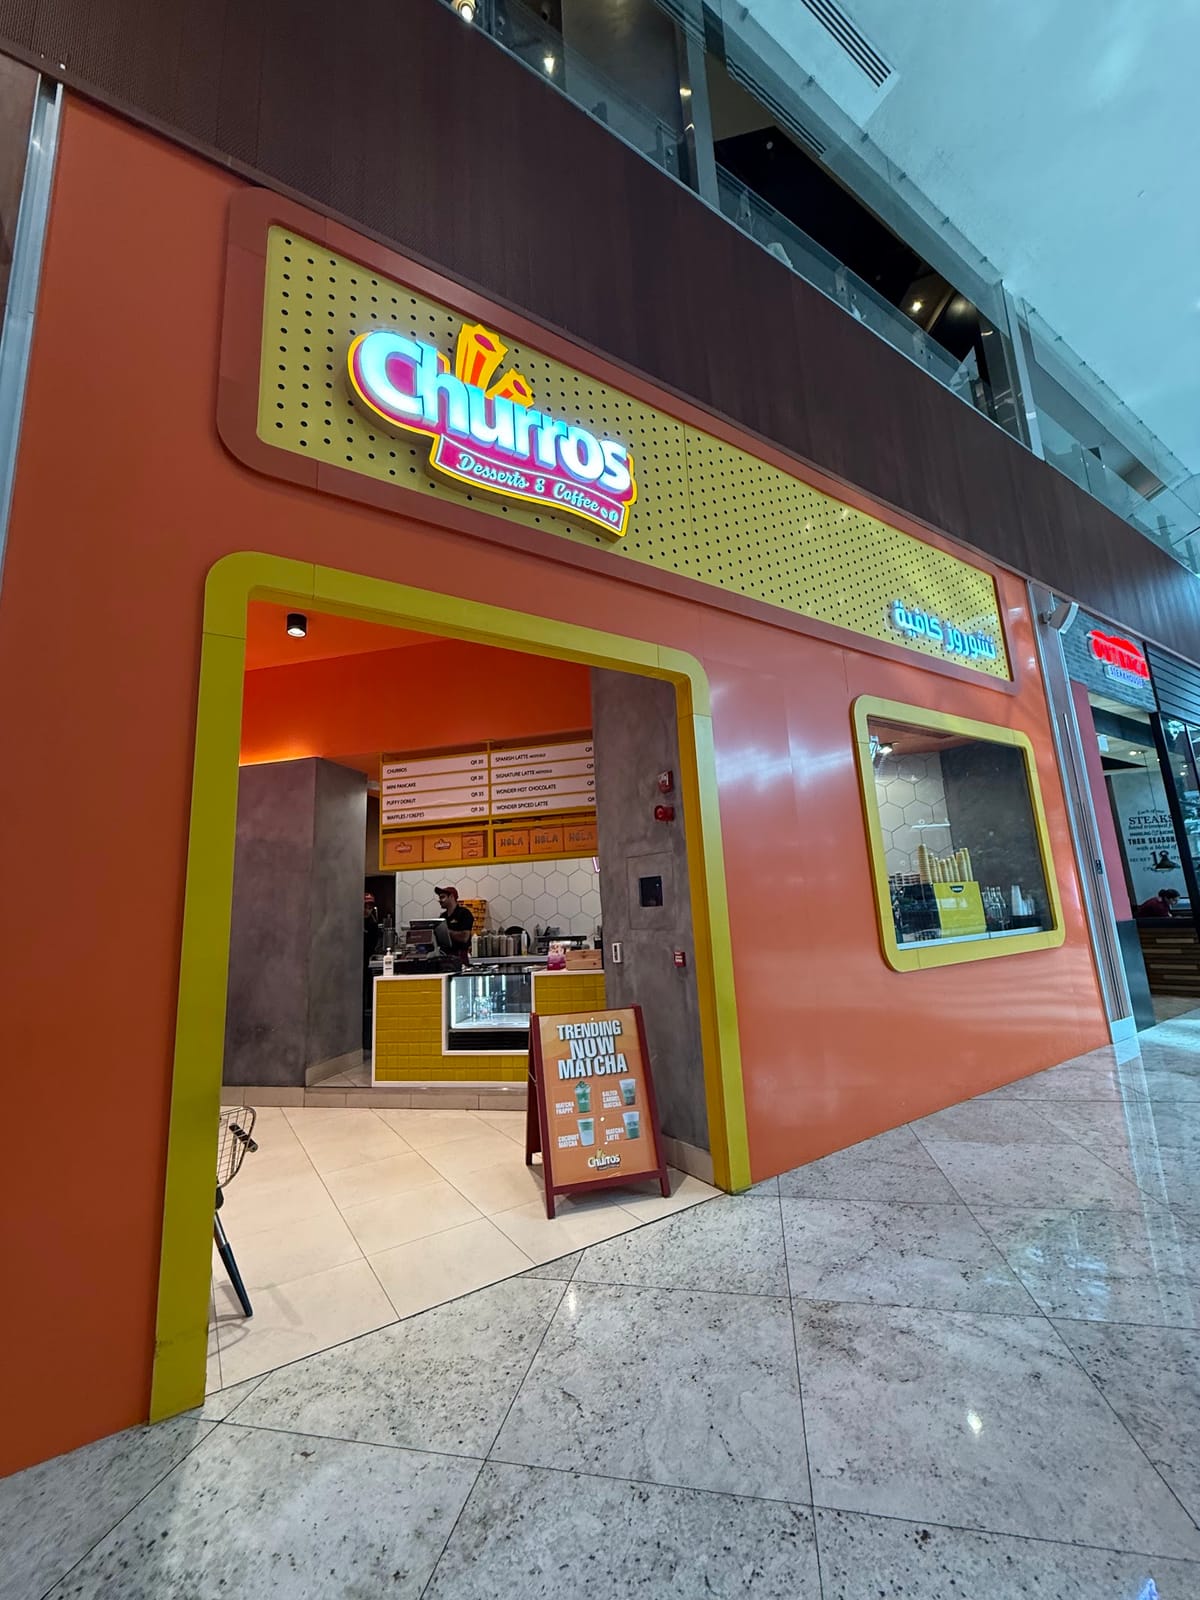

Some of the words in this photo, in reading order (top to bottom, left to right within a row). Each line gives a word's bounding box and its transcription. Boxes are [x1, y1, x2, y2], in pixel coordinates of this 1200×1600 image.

[360, 330, 630, 492] Churros
[457, 453, 529, 489] Desserts
[535, 478, 545, 492] &
[553, 481, 599, 511] Coffee
[1129, 814, 1172, 825] STEAKS
[556, 1019, 622, 1040] TRENDING
[569, 1036, 615, 1060] NOW
[558, 1053, 628, 1080] MATCHA
